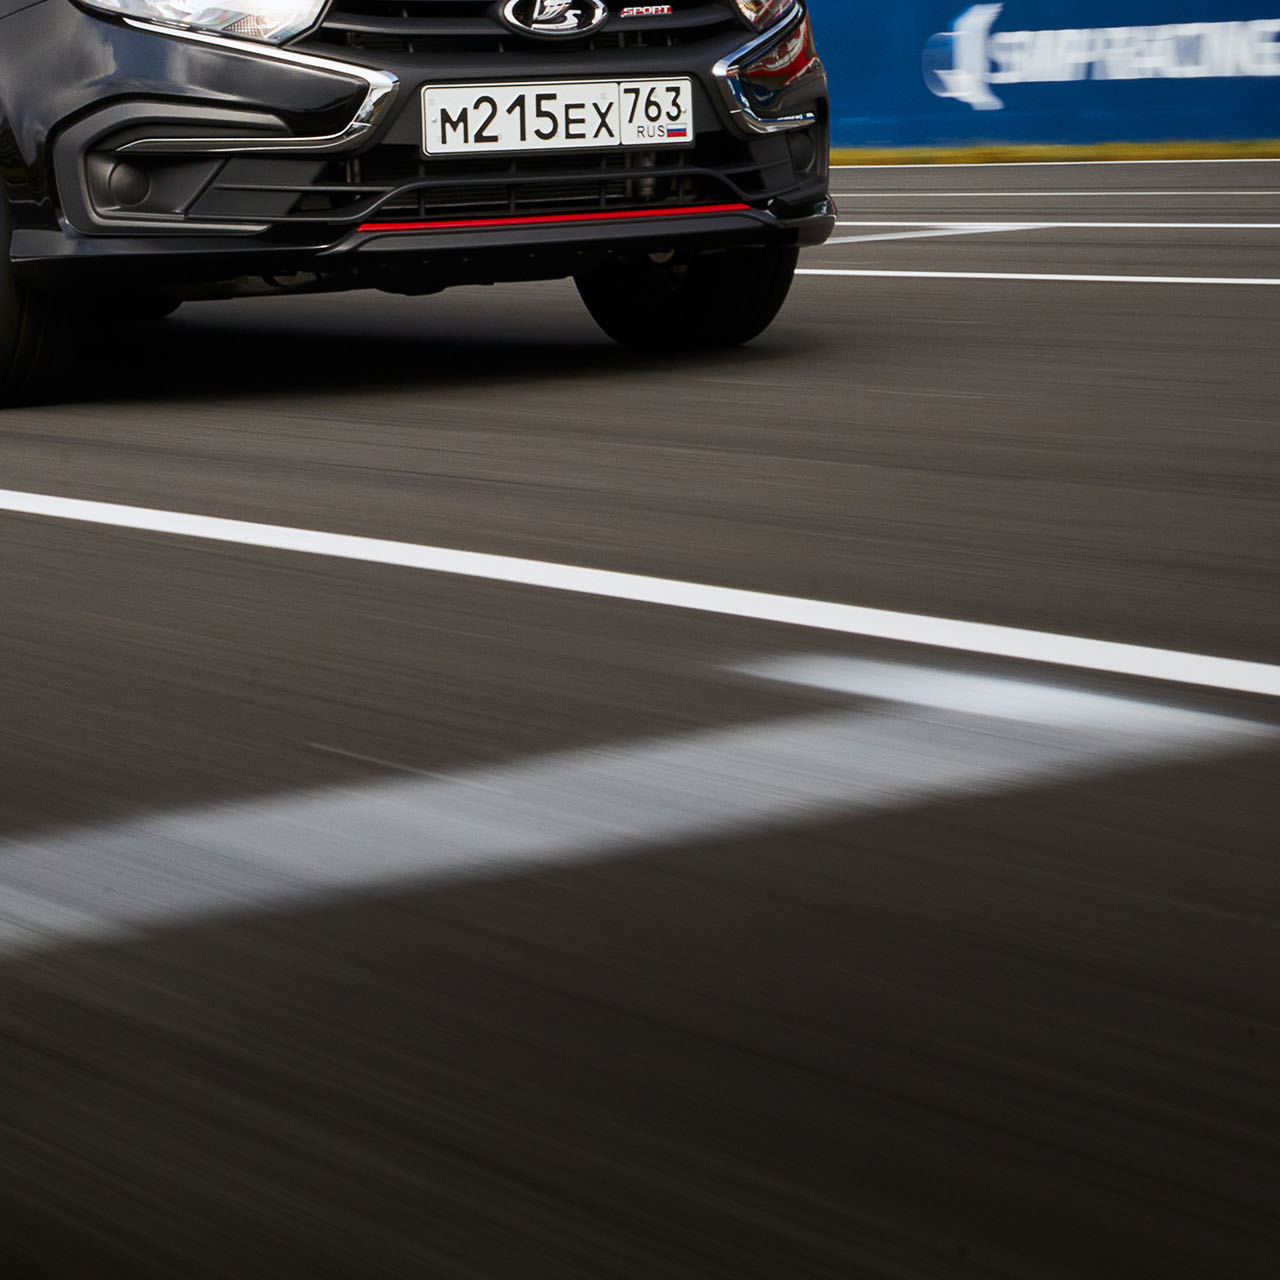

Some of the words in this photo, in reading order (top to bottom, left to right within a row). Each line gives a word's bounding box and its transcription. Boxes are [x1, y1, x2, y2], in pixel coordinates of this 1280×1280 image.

[621, 5, 672, 18] SPORT
[623, 86, 682, 124] 763
[637, 124, 665, 138] RUS
